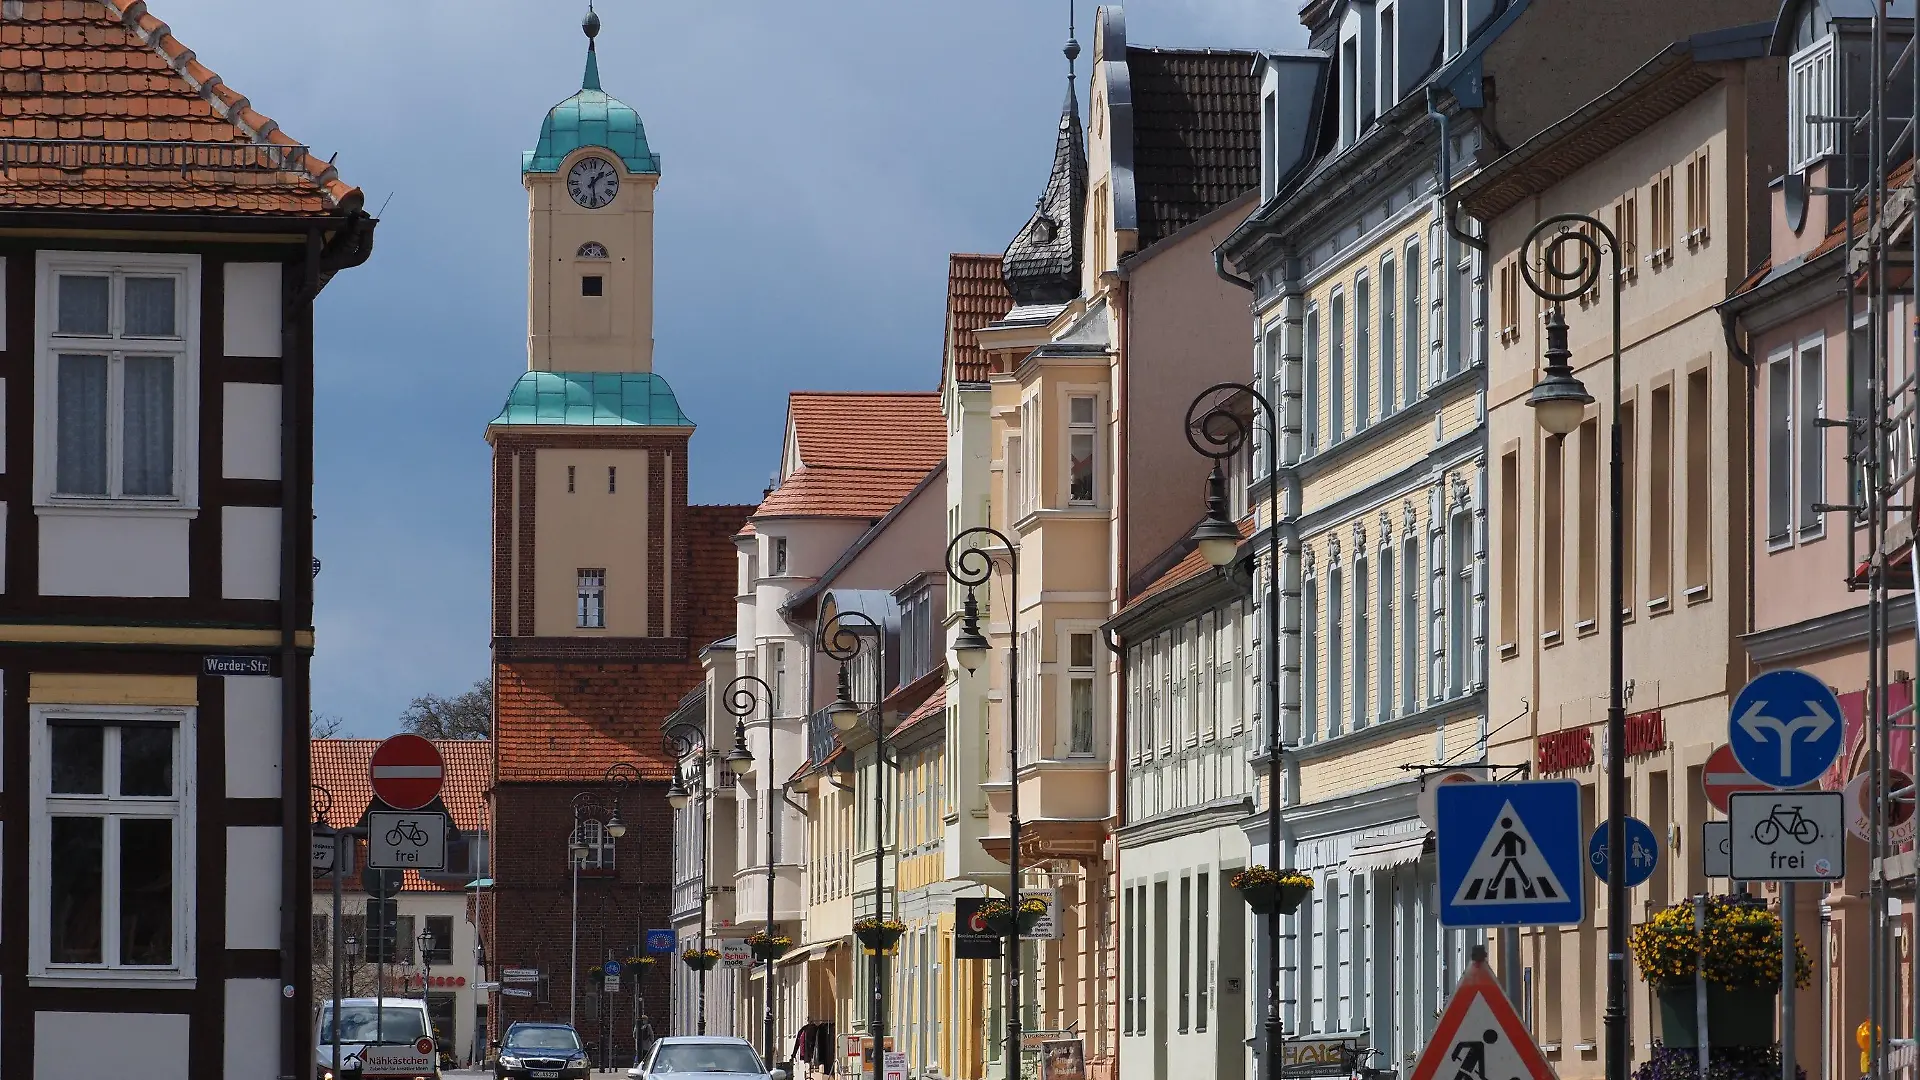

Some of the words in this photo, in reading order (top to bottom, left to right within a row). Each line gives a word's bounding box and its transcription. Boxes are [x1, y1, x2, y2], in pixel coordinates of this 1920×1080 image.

[206, 658, 269, 672] Werder-Str.
[396, 850, 419, 862] frei
[1771, 850, 1804, 869] frei
[724, 952, 751, 961] Schuh-
[369, 1056, 429, 1065] Nähkästchen
